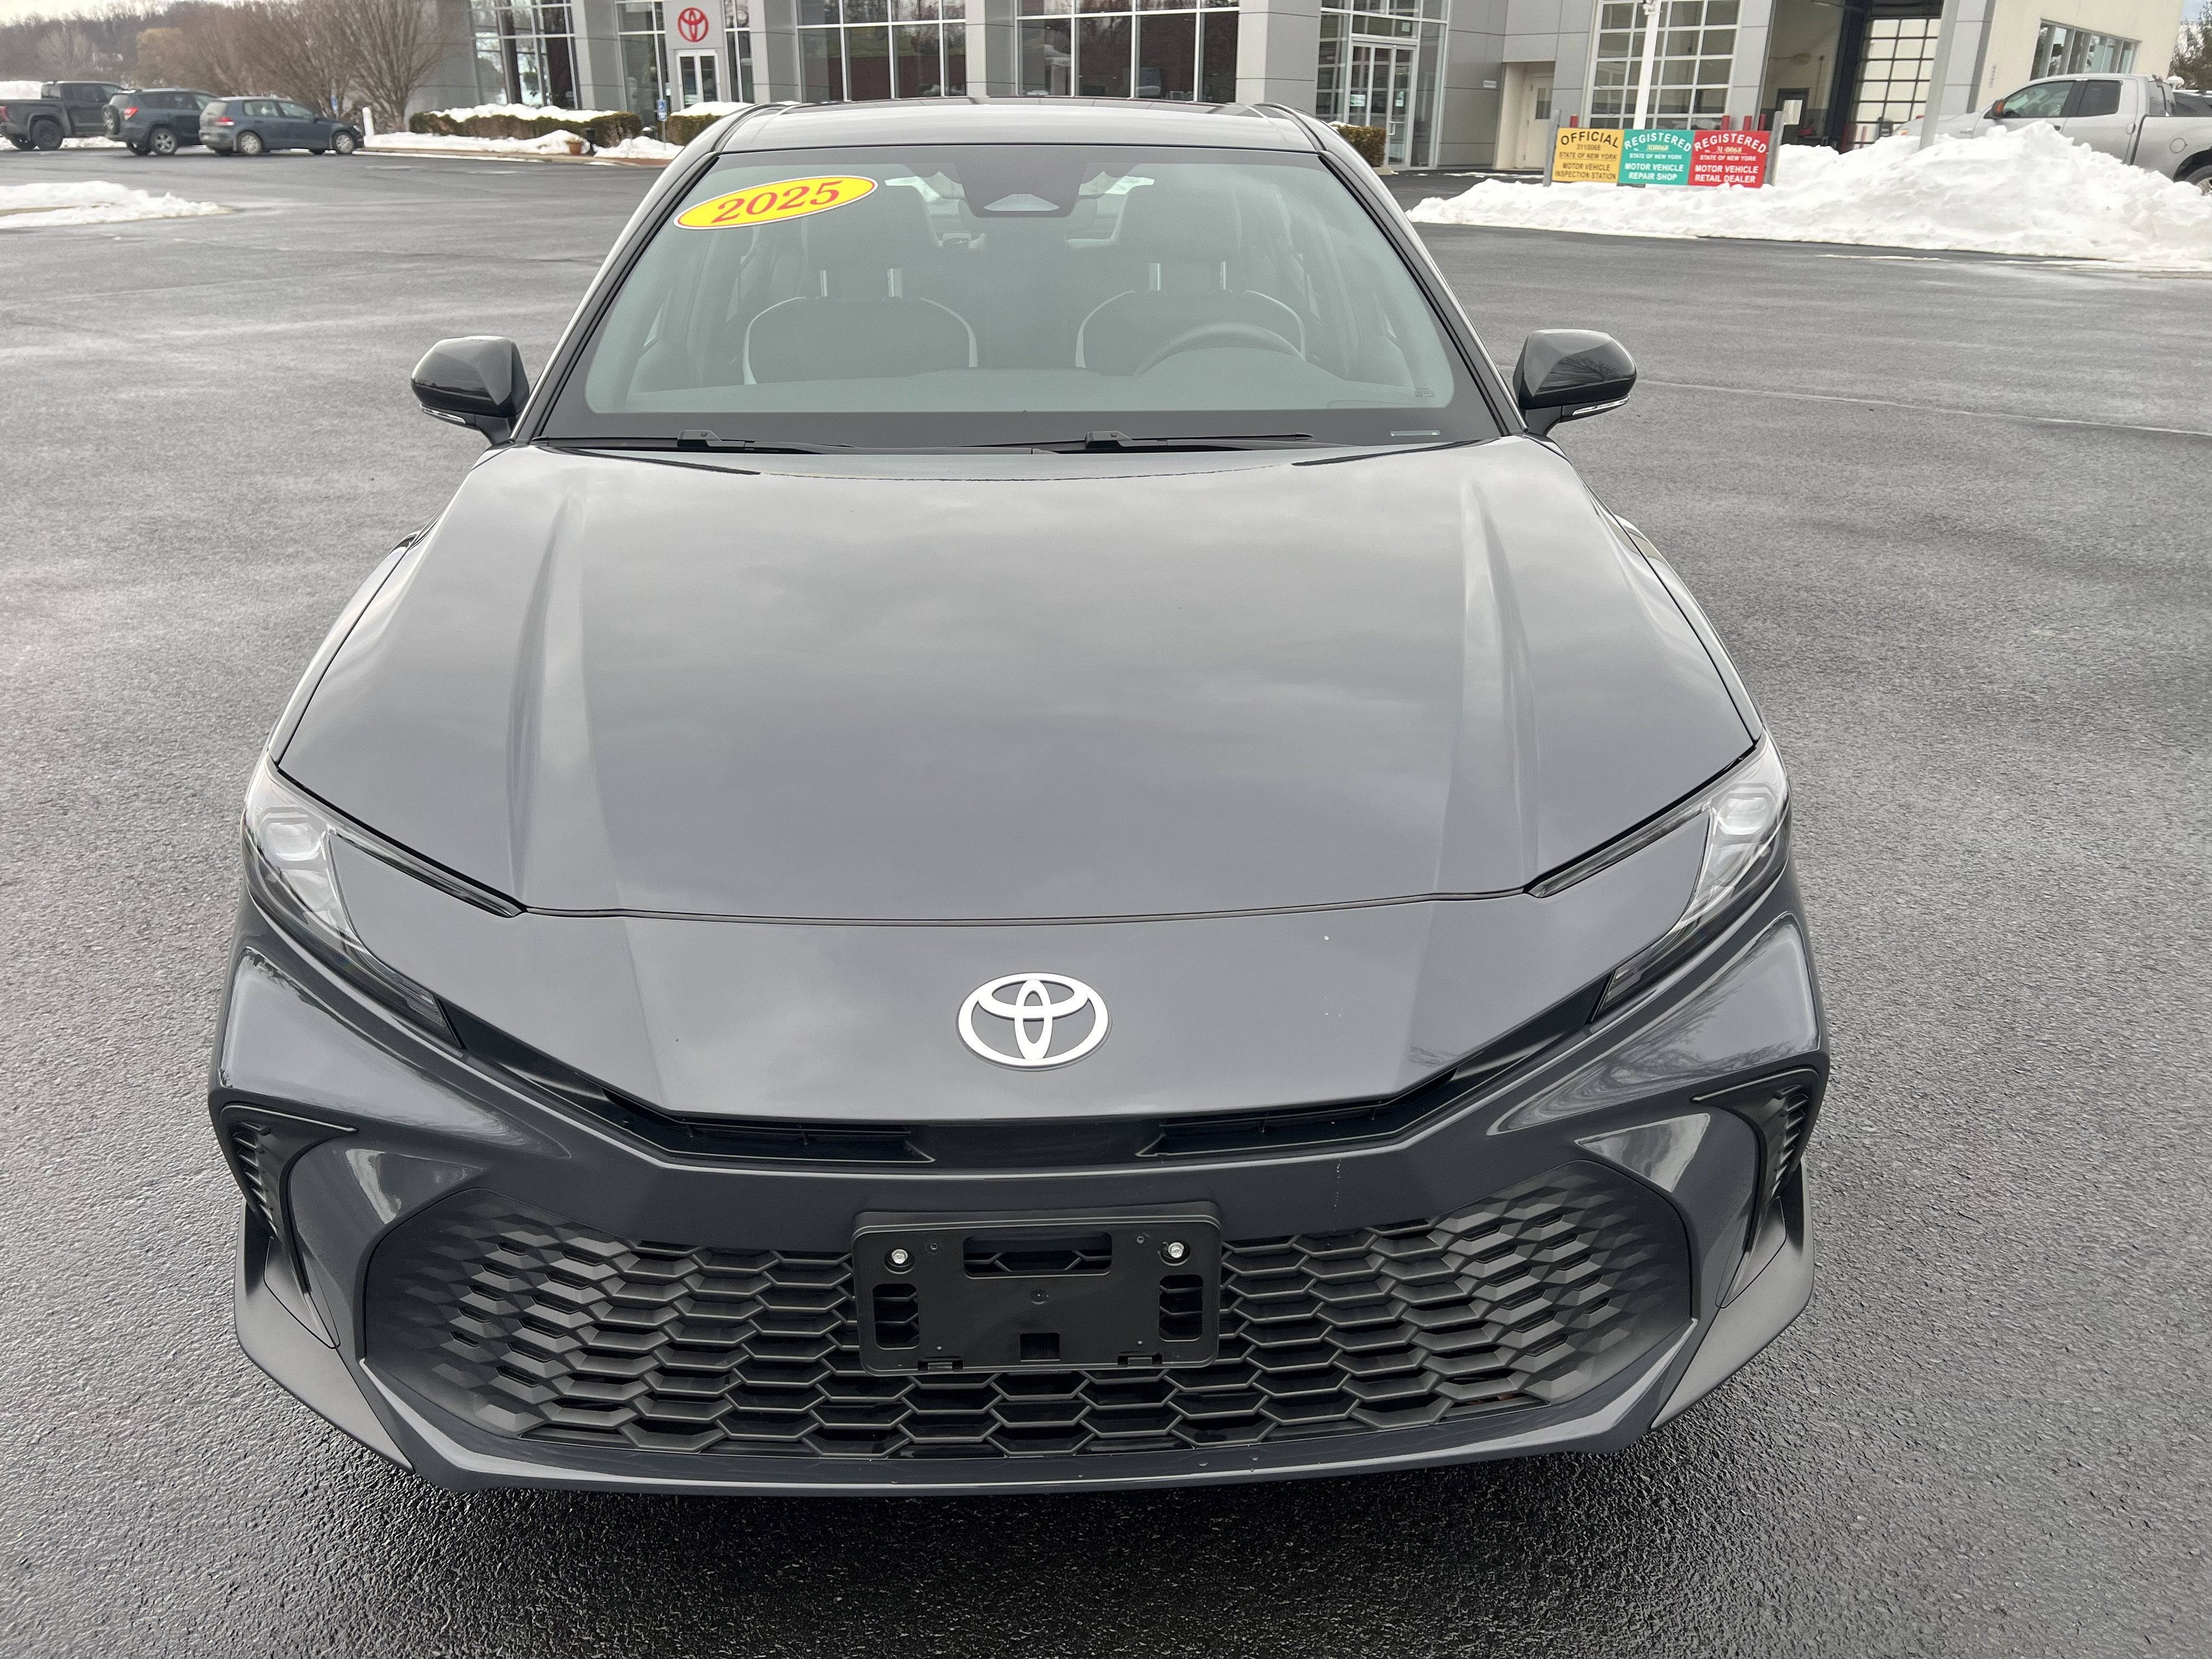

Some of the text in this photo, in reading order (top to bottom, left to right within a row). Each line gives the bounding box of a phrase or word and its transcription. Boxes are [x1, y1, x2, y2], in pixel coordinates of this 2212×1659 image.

[1561, 132, 1618, 148] OFFICIAL
[1624, 132, 1691, 152] REGISTERED
[1694, 133, 1767, 153] REGISTERED
[1695, 174, 1756, 183] RETAIL DEALER
[1725, 166, 1759, 174] VEHICLE
[710, 180, 843, 224] 2025
